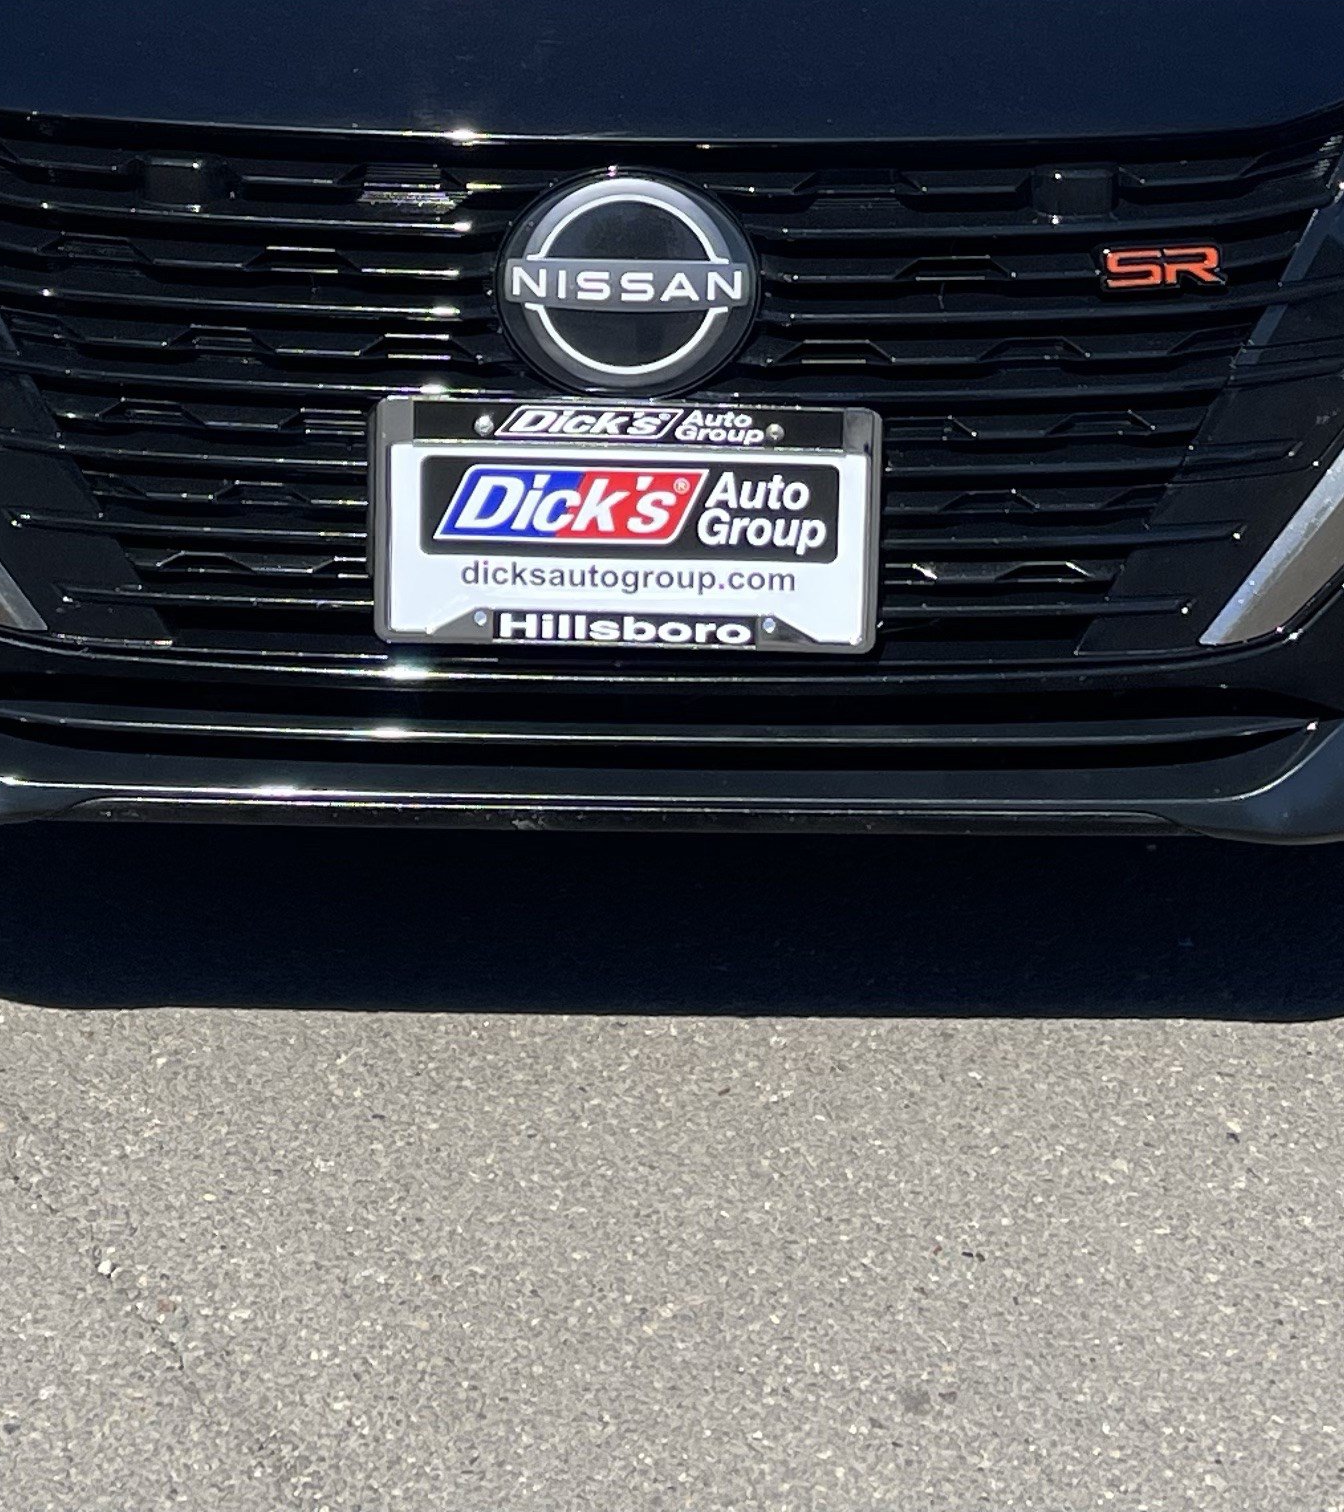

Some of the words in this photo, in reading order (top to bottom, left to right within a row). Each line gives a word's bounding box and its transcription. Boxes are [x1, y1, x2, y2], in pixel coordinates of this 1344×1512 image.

[512, 266, 743, 302] NISSAN
[1106, 244, 1225, 288] SR
[674, 424, 766, 446] Group
[681, 408, 754, 429] Auto
[704, 471, 810, 512] Auto
[697, 507, 828, 556] Group
[460, 559, 797, 595] dicksautogroup.com
[498, 611, 753, 645] Hillsboro
